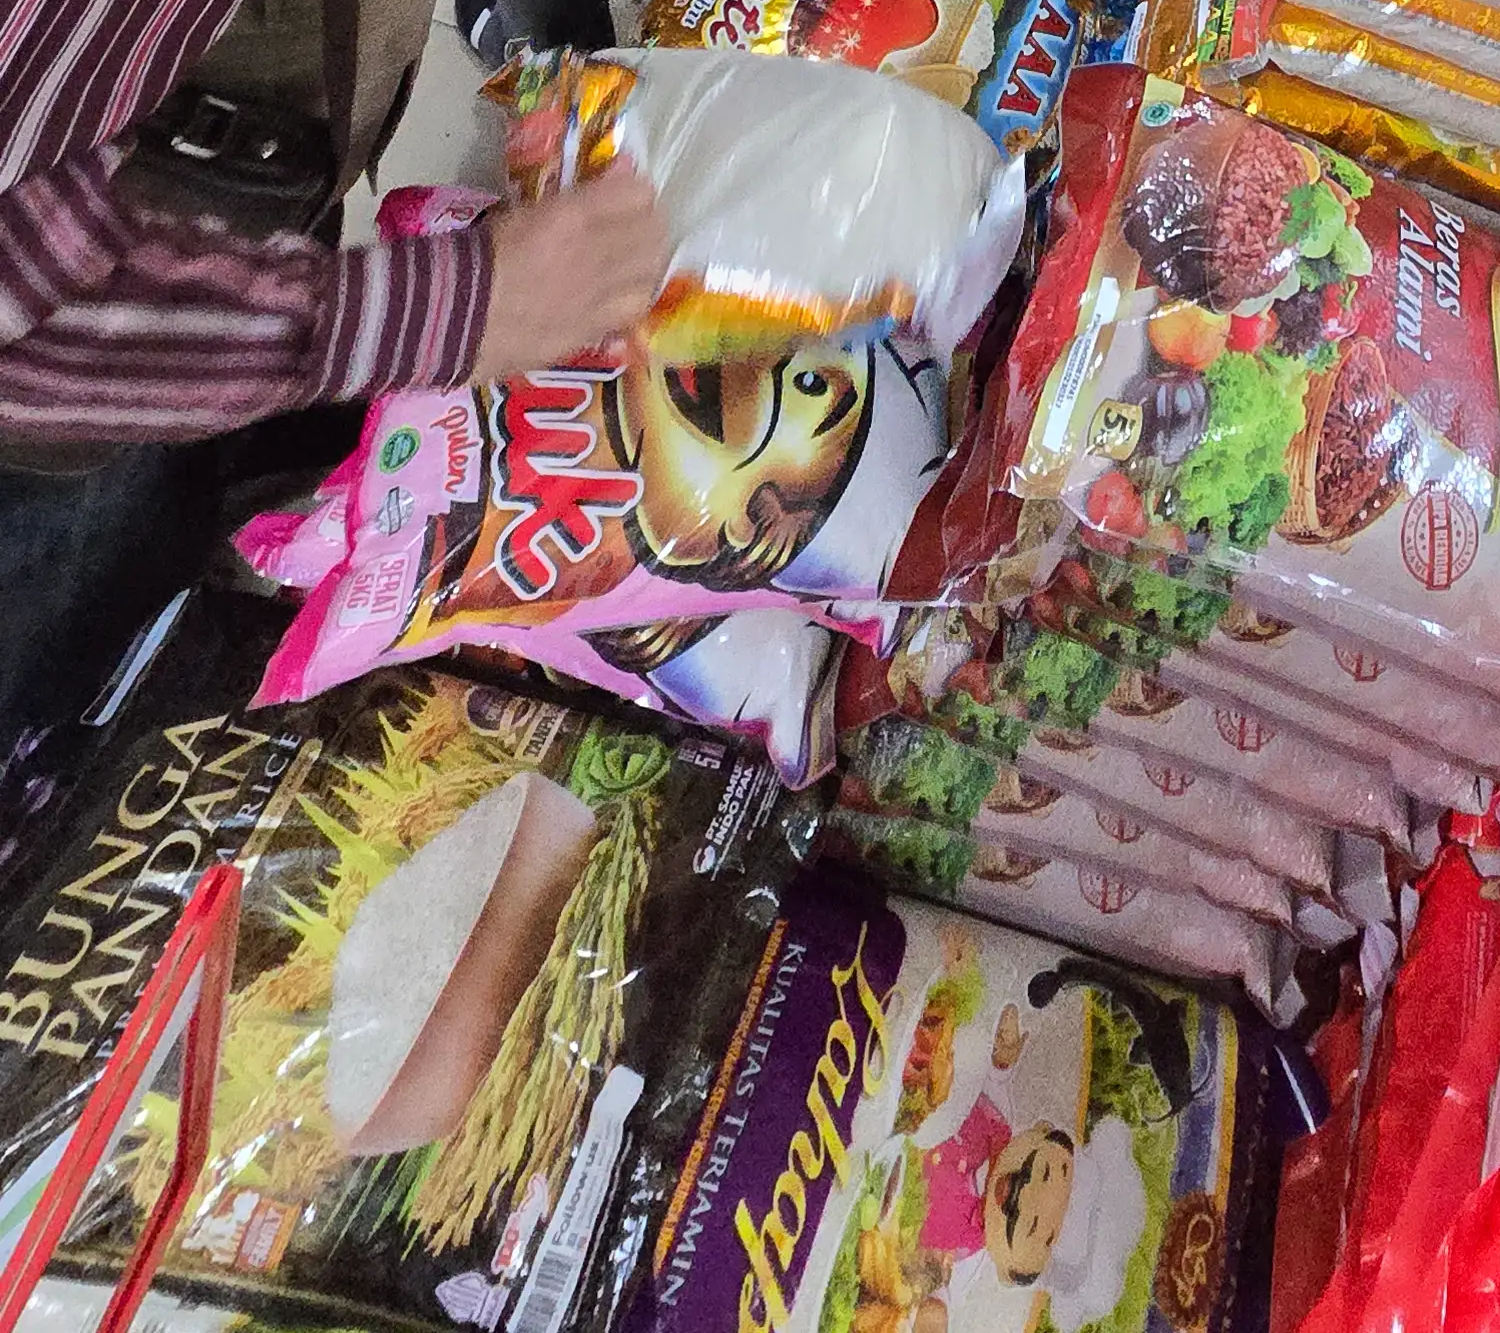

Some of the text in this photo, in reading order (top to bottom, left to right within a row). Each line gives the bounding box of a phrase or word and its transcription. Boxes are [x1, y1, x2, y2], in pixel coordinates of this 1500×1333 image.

[1393, 206, 1434, 363] Alami
[1428, 199, 1465, 319] Beras
[346, 572, 368, 611] 5KG
[371, 553, 404, 617] BERAT
[235, 730, 302, 824] RICE
[713, 800, 741, 846] INDO
[0, 713, 230, 1056] BUNGA
[33, 721, 272, 1062] PANDAN
[734, 940, 807, 1099] KUALITAS
[551, 1141, 599, 1247] Follow us
[660, 1107, 750, 1308] TERJAMIN
